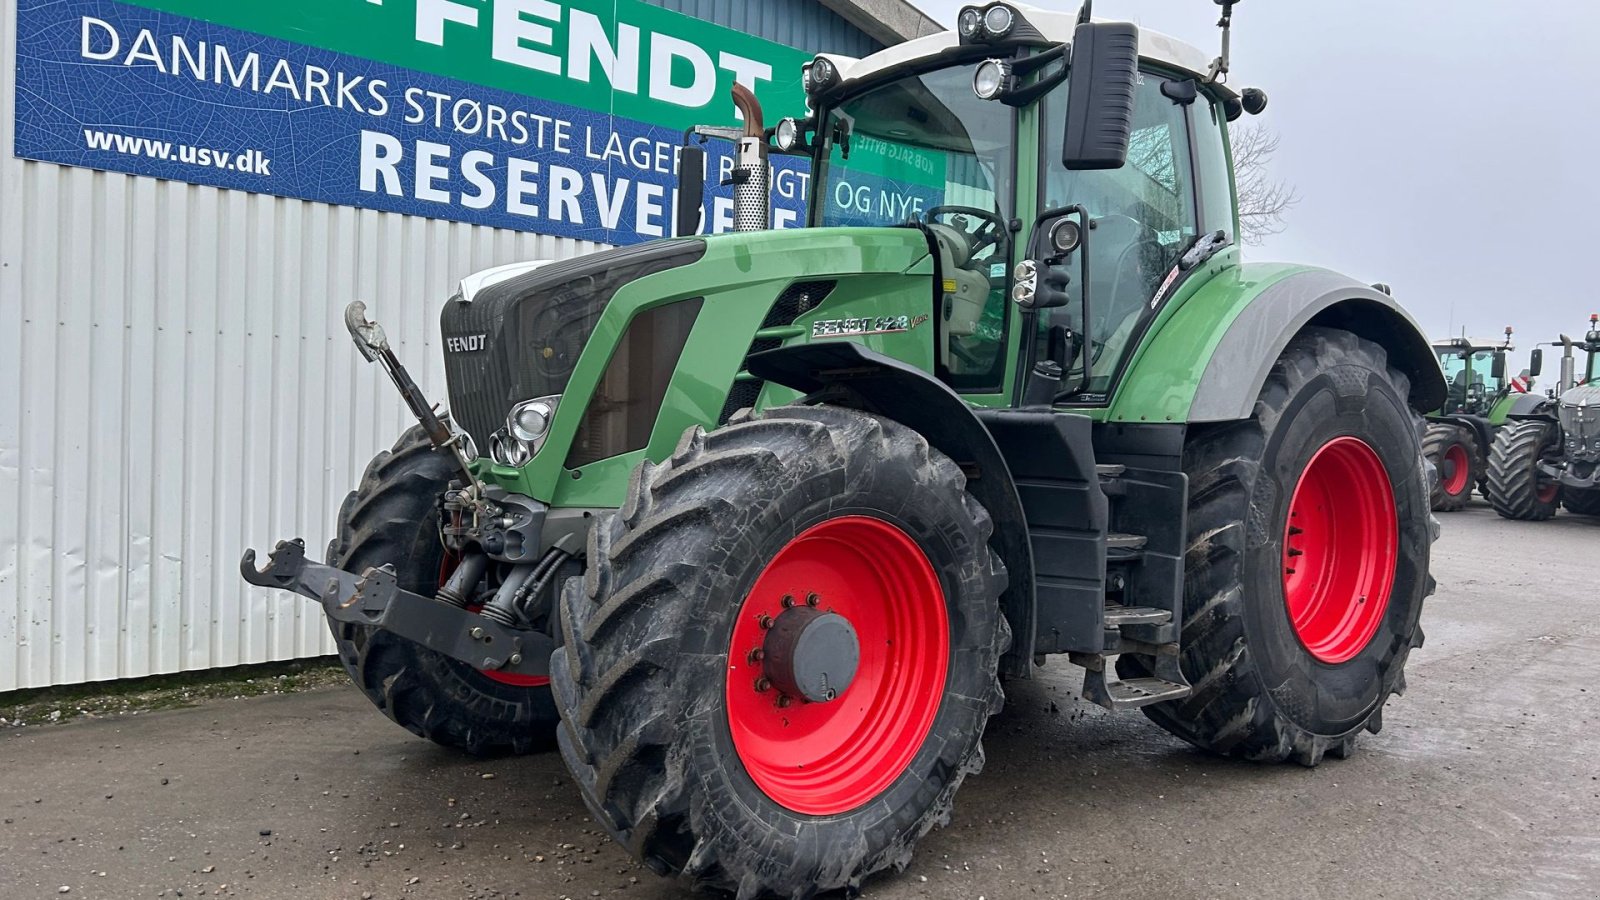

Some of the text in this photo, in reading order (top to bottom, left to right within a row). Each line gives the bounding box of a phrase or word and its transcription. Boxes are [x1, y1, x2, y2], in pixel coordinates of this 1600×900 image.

[415, 0, 773, 120] FENDT
[81, 15, 389, 117] DANMARKS
[404, 87, 572, 154] STØRSTE
[835, 181, 871, 213] OG
[84, 129, 271, 176] www.usv.dk
[446, 334, 486, 353] FENDT
[813, 317, 873, 337] FENDT
